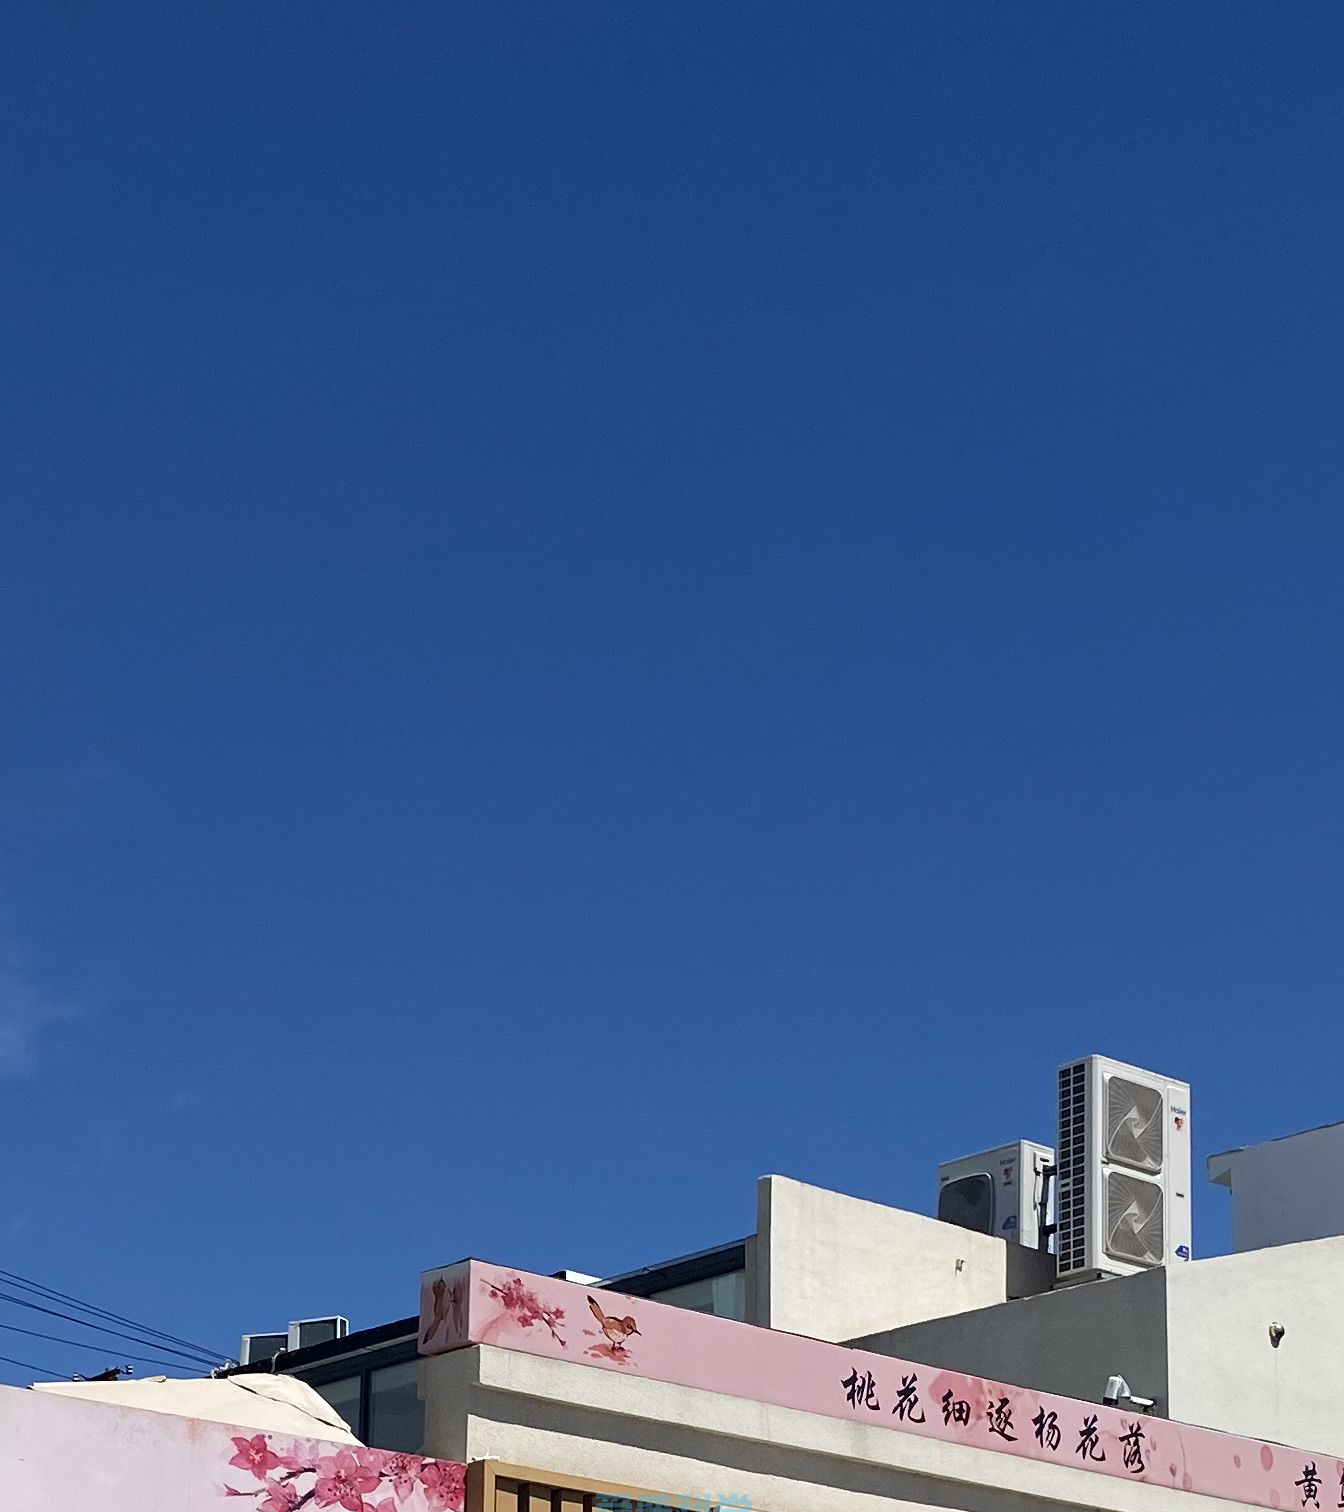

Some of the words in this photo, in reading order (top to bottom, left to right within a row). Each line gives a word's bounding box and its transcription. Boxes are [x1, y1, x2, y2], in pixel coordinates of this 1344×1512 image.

[841, 1367, 1146, 1474] 桃花细逐杨花落
